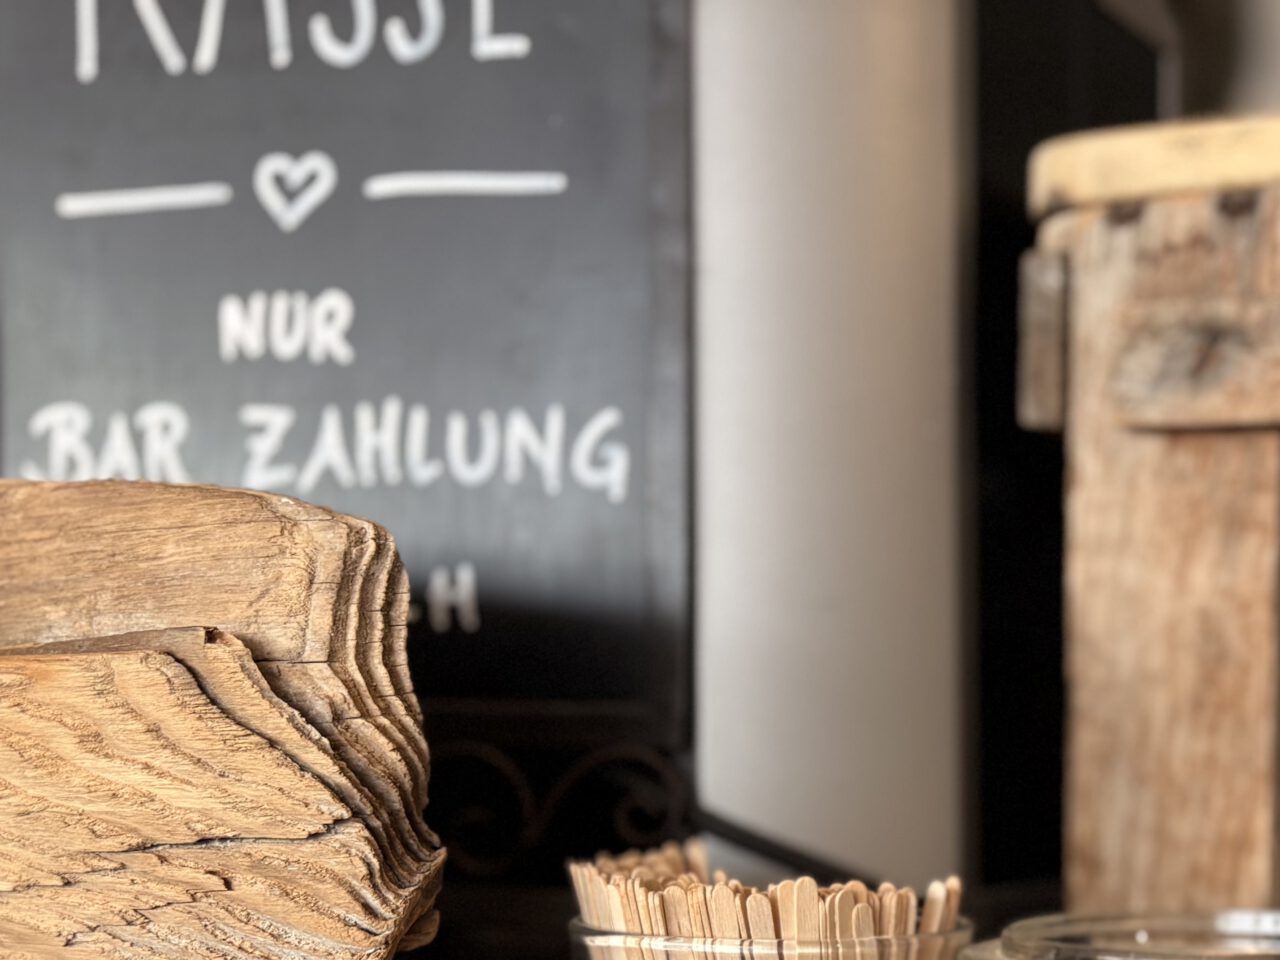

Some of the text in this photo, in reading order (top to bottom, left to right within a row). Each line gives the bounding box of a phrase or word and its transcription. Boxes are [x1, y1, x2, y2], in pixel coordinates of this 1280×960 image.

[218, 287, 356, 366] NUR
[22, 395, 631, 502] BAR ZAHLUNG
